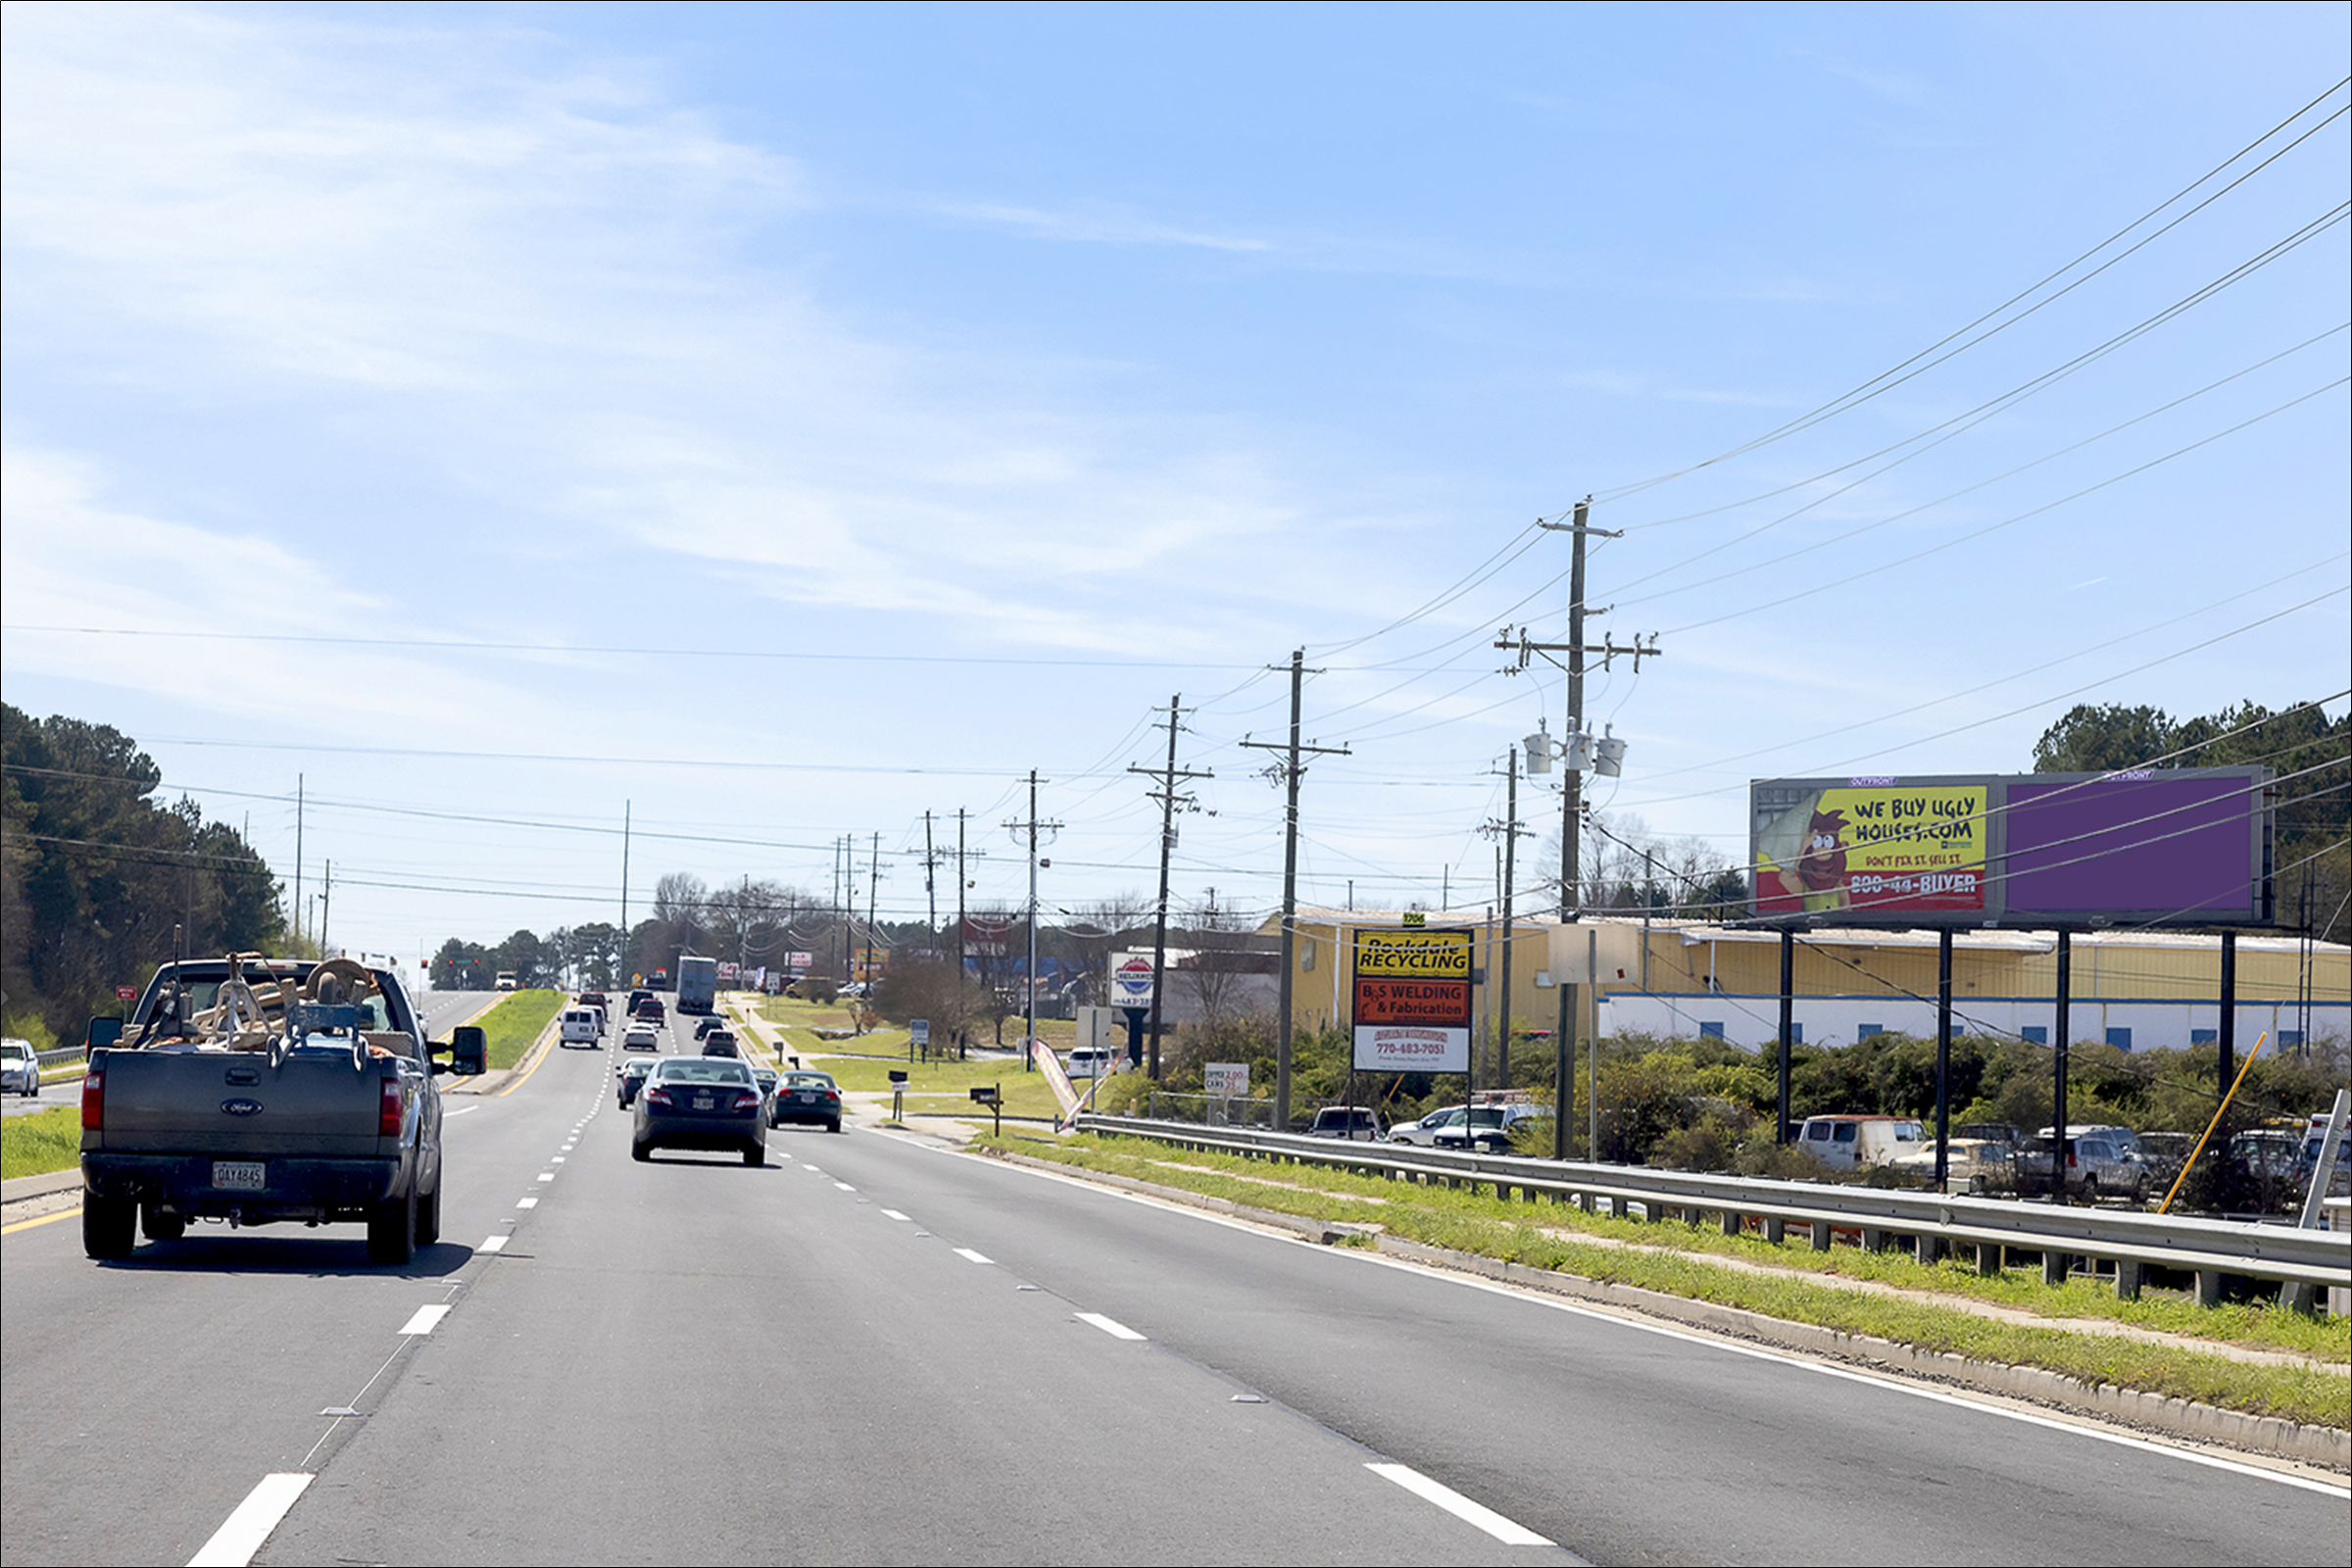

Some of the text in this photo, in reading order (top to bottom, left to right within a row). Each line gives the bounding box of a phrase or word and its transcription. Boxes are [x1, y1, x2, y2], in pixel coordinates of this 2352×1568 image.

[1855, 797, 1975, 819] WE BUY UGLY
[1929, 854, 1946, 866] SELL
[1367, 940, 1459, 955] Rockdale
[1360, 954, 1466, 969] RECYCLING
[1391, 986, 1461, 1000] WELDING
[1377, 1002, 1461, 1014] & Fabrication
[1376, 1043, 1445, 1054] 770-483-7051
